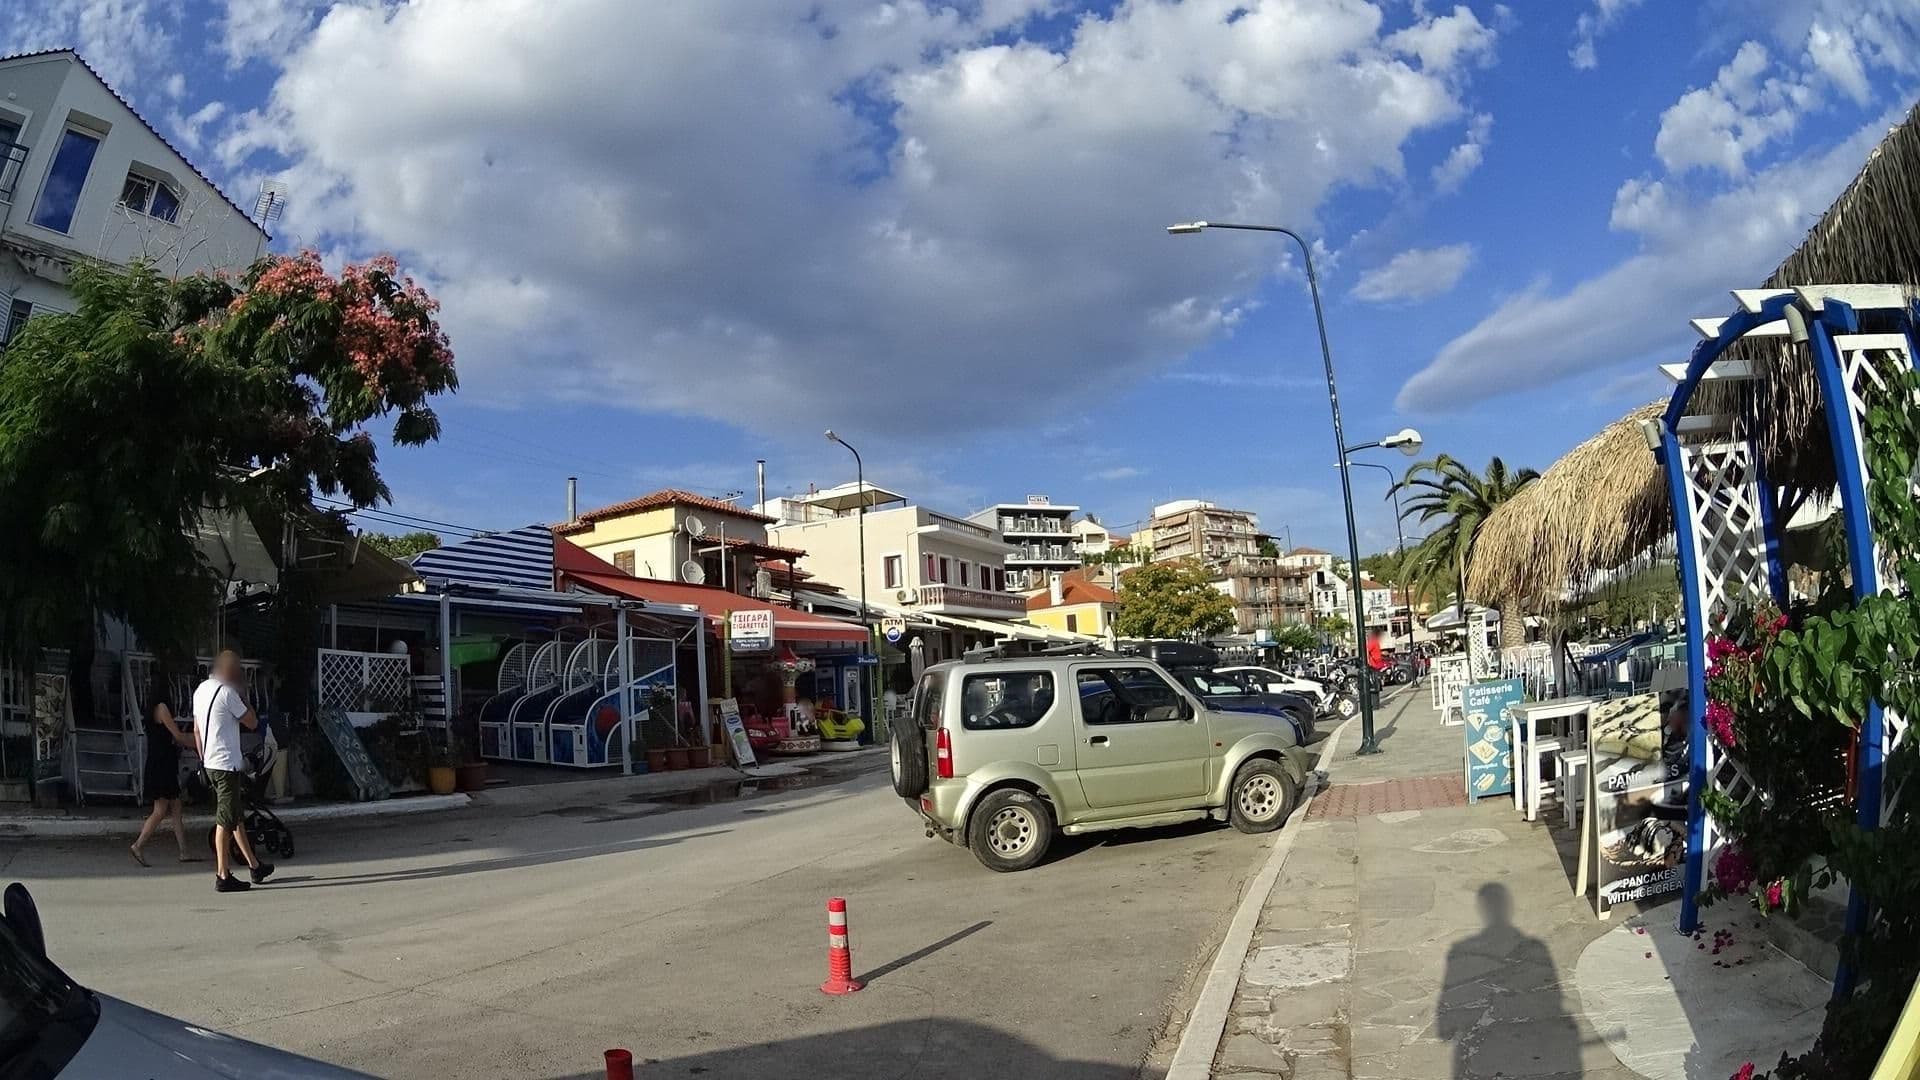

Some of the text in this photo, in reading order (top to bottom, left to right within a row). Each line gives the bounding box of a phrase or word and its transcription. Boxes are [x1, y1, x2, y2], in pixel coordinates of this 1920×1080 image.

[733, 614, 768, 622] ΤΣΙΓΑΡΑ
[1469, 683, 1513, 697] Patisserie
[1470, 695, 1490, 706] Café
[1608, 764, 1679, 790] PANCS
[1623, 868, 1677, 889] PANCAKES
[1607, 889, 1634, 905] WITH
[1635, 886, 1652, 899] ICE
